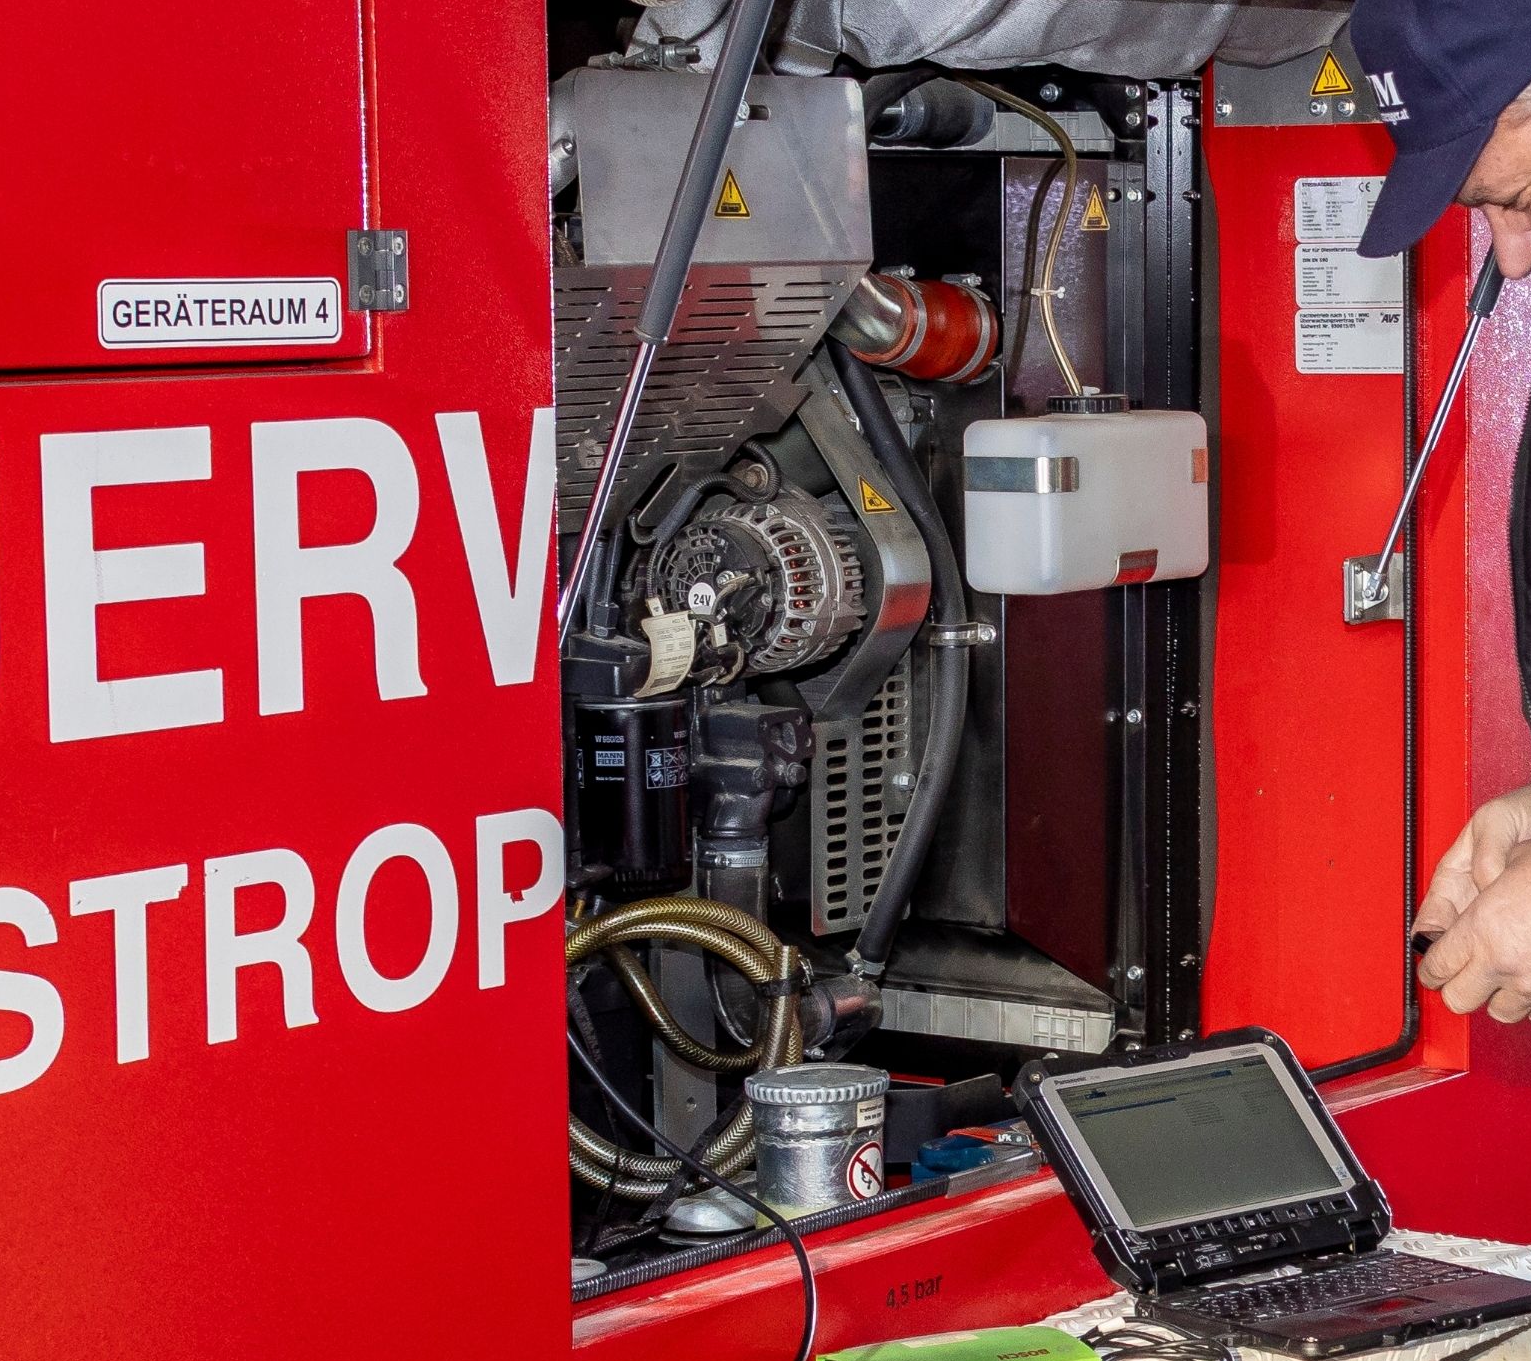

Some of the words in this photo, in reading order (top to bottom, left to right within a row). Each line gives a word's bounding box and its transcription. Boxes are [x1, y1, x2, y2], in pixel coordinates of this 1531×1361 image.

[112, 293, 307, 329] GERÄTERAUM
[315, 297, 330, 325] 4
[1381, 313, 1401, 324] AVS
[693, 593, 712, 607] 24V
[885, 1282, 910, 1309] 4,5
[914, 1274, 943, 1300] bar
[996, 1347, 1051, 1361] BOSCH
